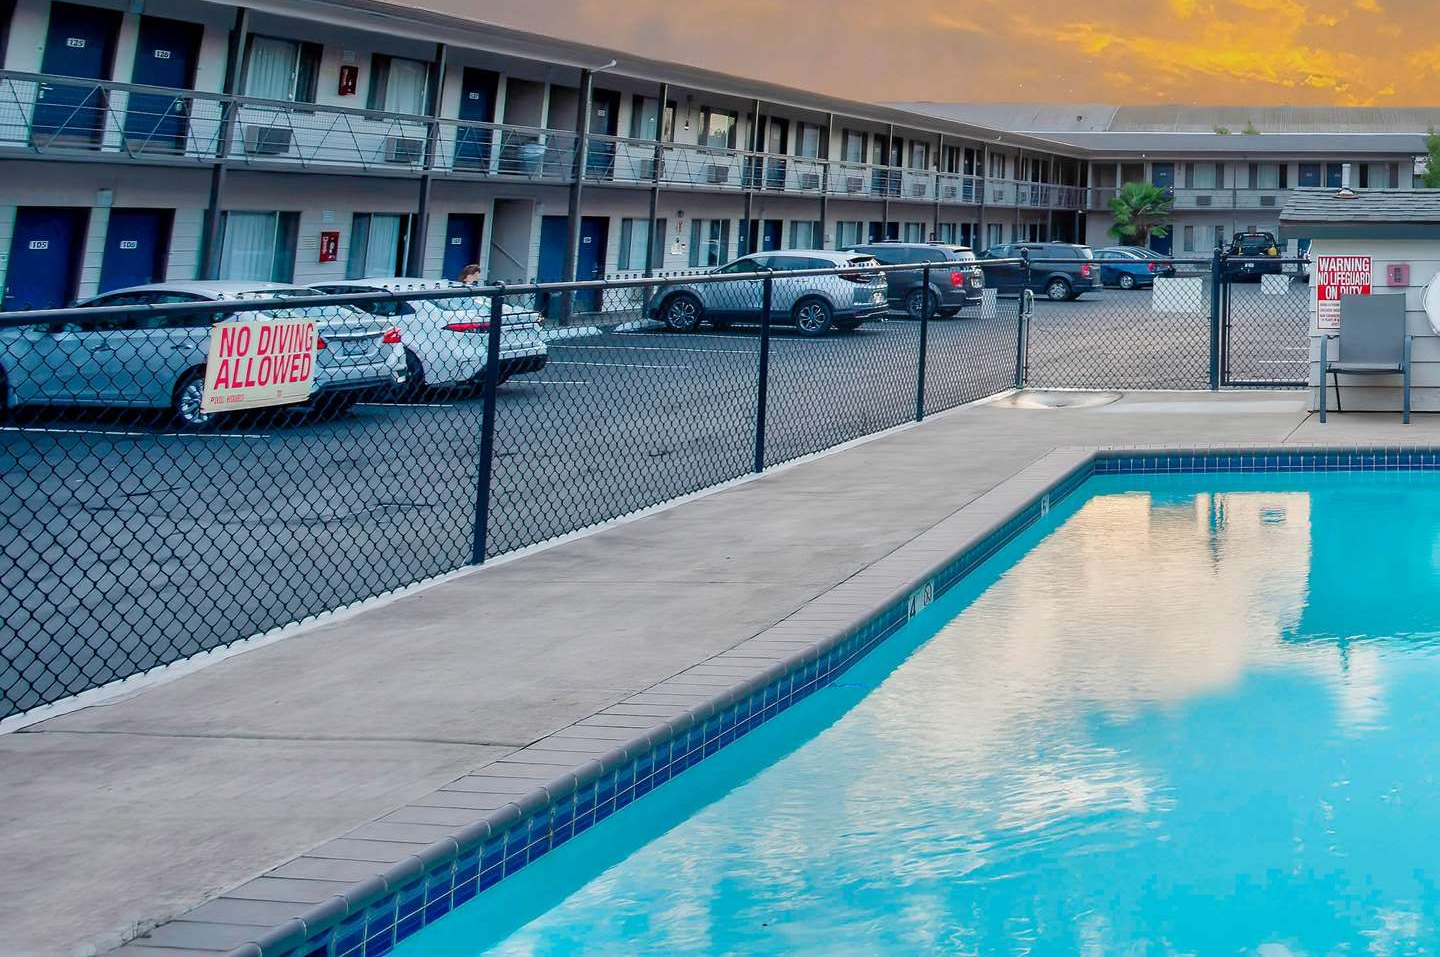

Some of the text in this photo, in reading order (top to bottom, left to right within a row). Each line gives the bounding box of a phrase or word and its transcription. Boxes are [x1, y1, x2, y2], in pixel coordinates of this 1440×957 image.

[31, 241, 47, 249] 105
[1319, 258, 1370, 272] WARNING
[1318, 272, 1370, 285] NO LIFEGUARD
[1325, 286, 1338, 300] ON
[219, 322, 314, 358] NO DIVING
[213, 353, 311, 390] ALLOWED
